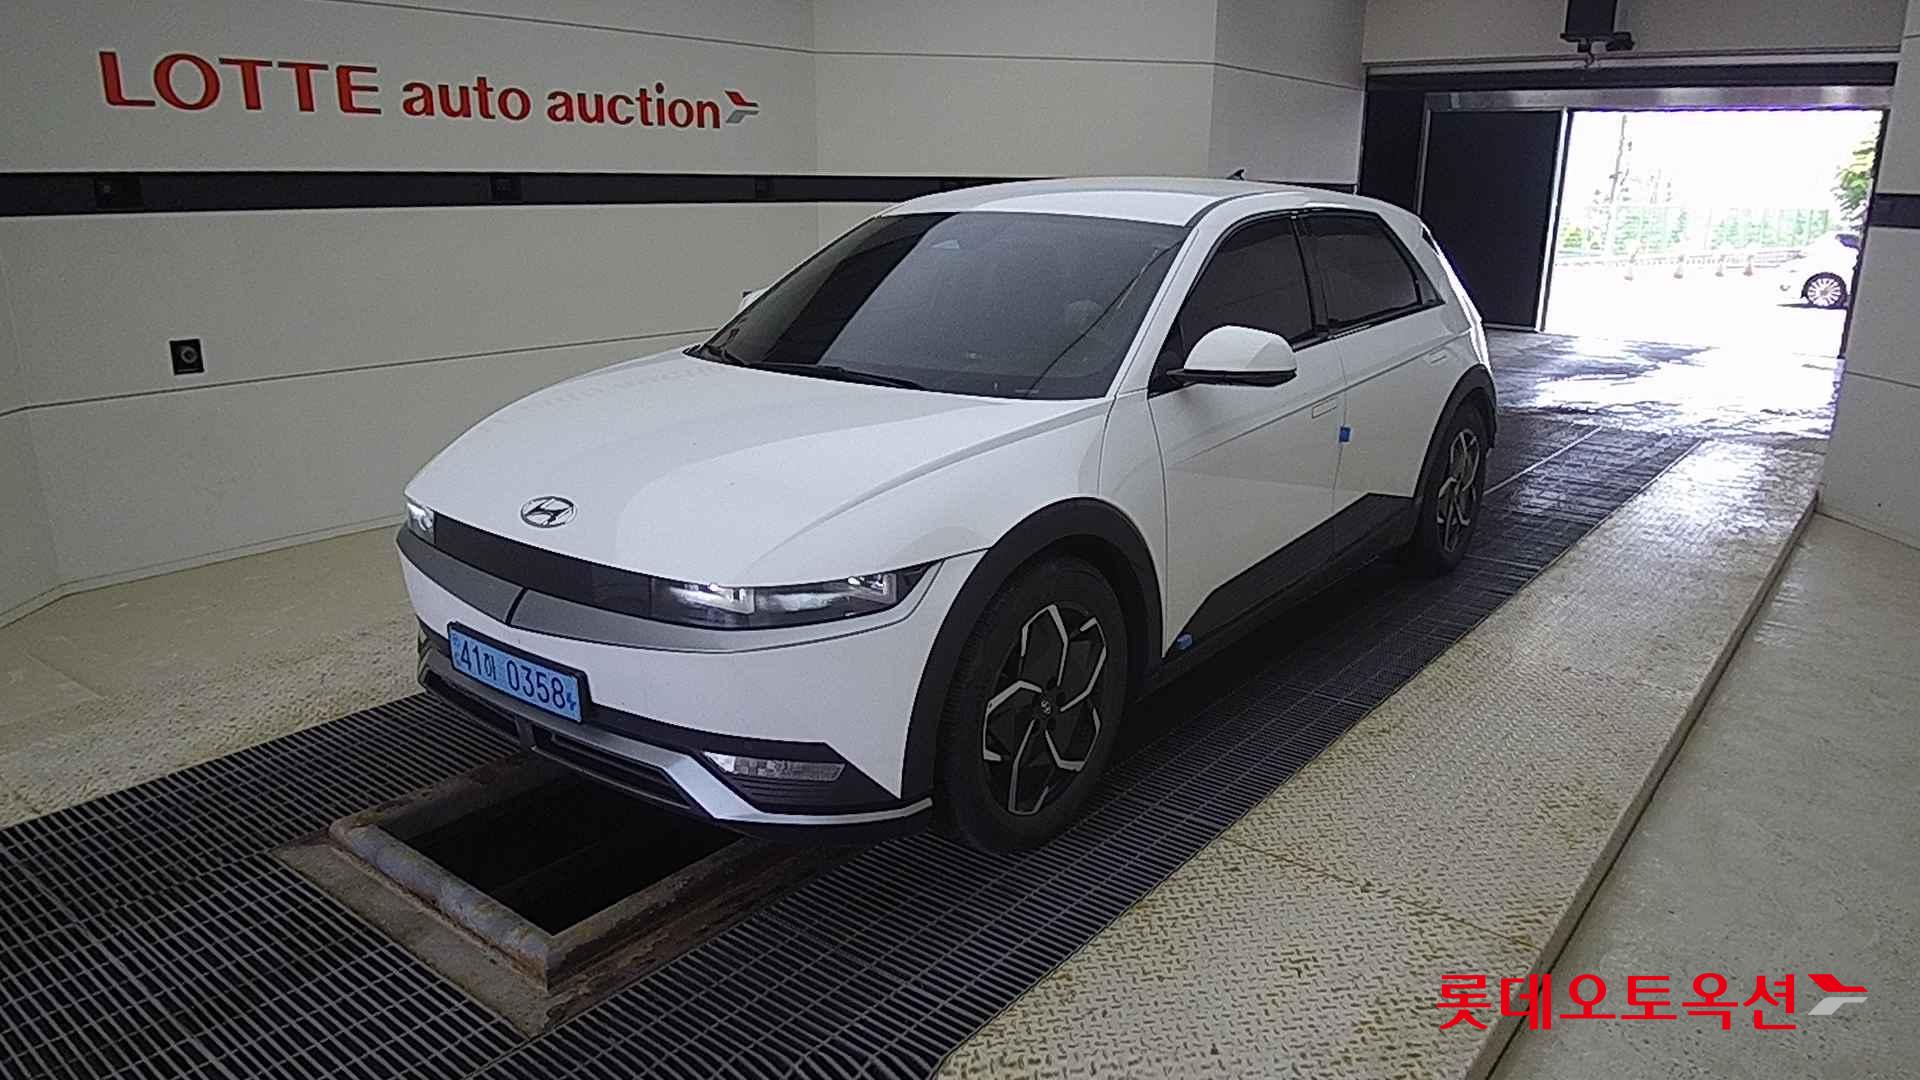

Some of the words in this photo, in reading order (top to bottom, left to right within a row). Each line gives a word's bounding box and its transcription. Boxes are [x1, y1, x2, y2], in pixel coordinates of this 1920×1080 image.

[99, 51, 382, 115] LOTTE
[403, 76, 531, 121] auto
[547, 82, 721, 129] auction
[506, 659, 566, 709] 0358
